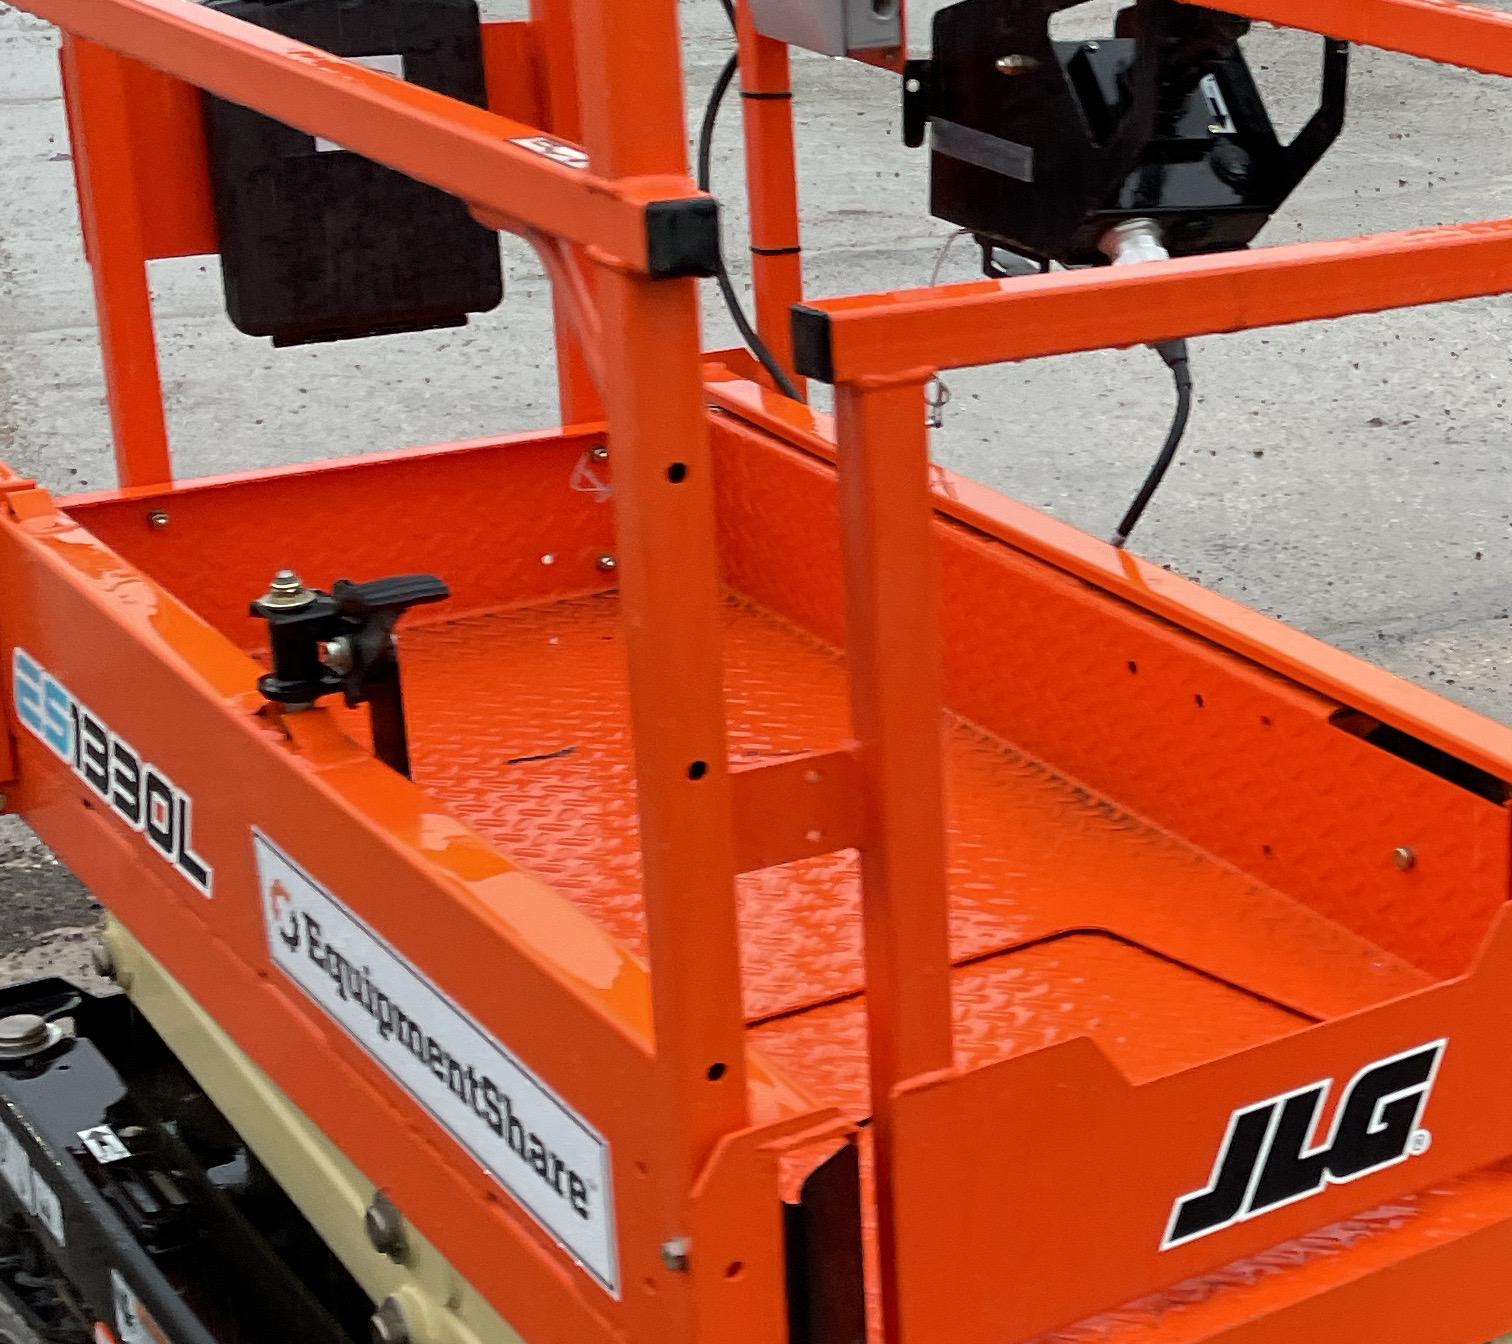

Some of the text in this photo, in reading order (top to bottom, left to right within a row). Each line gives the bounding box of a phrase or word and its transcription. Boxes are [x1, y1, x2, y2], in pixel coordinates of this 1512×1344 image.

[12, 647, 214, 899] ES1330L
[301, 910, 592, 1222] EquipmentShare
[1158, 1037, 1449, 1252] JLG
